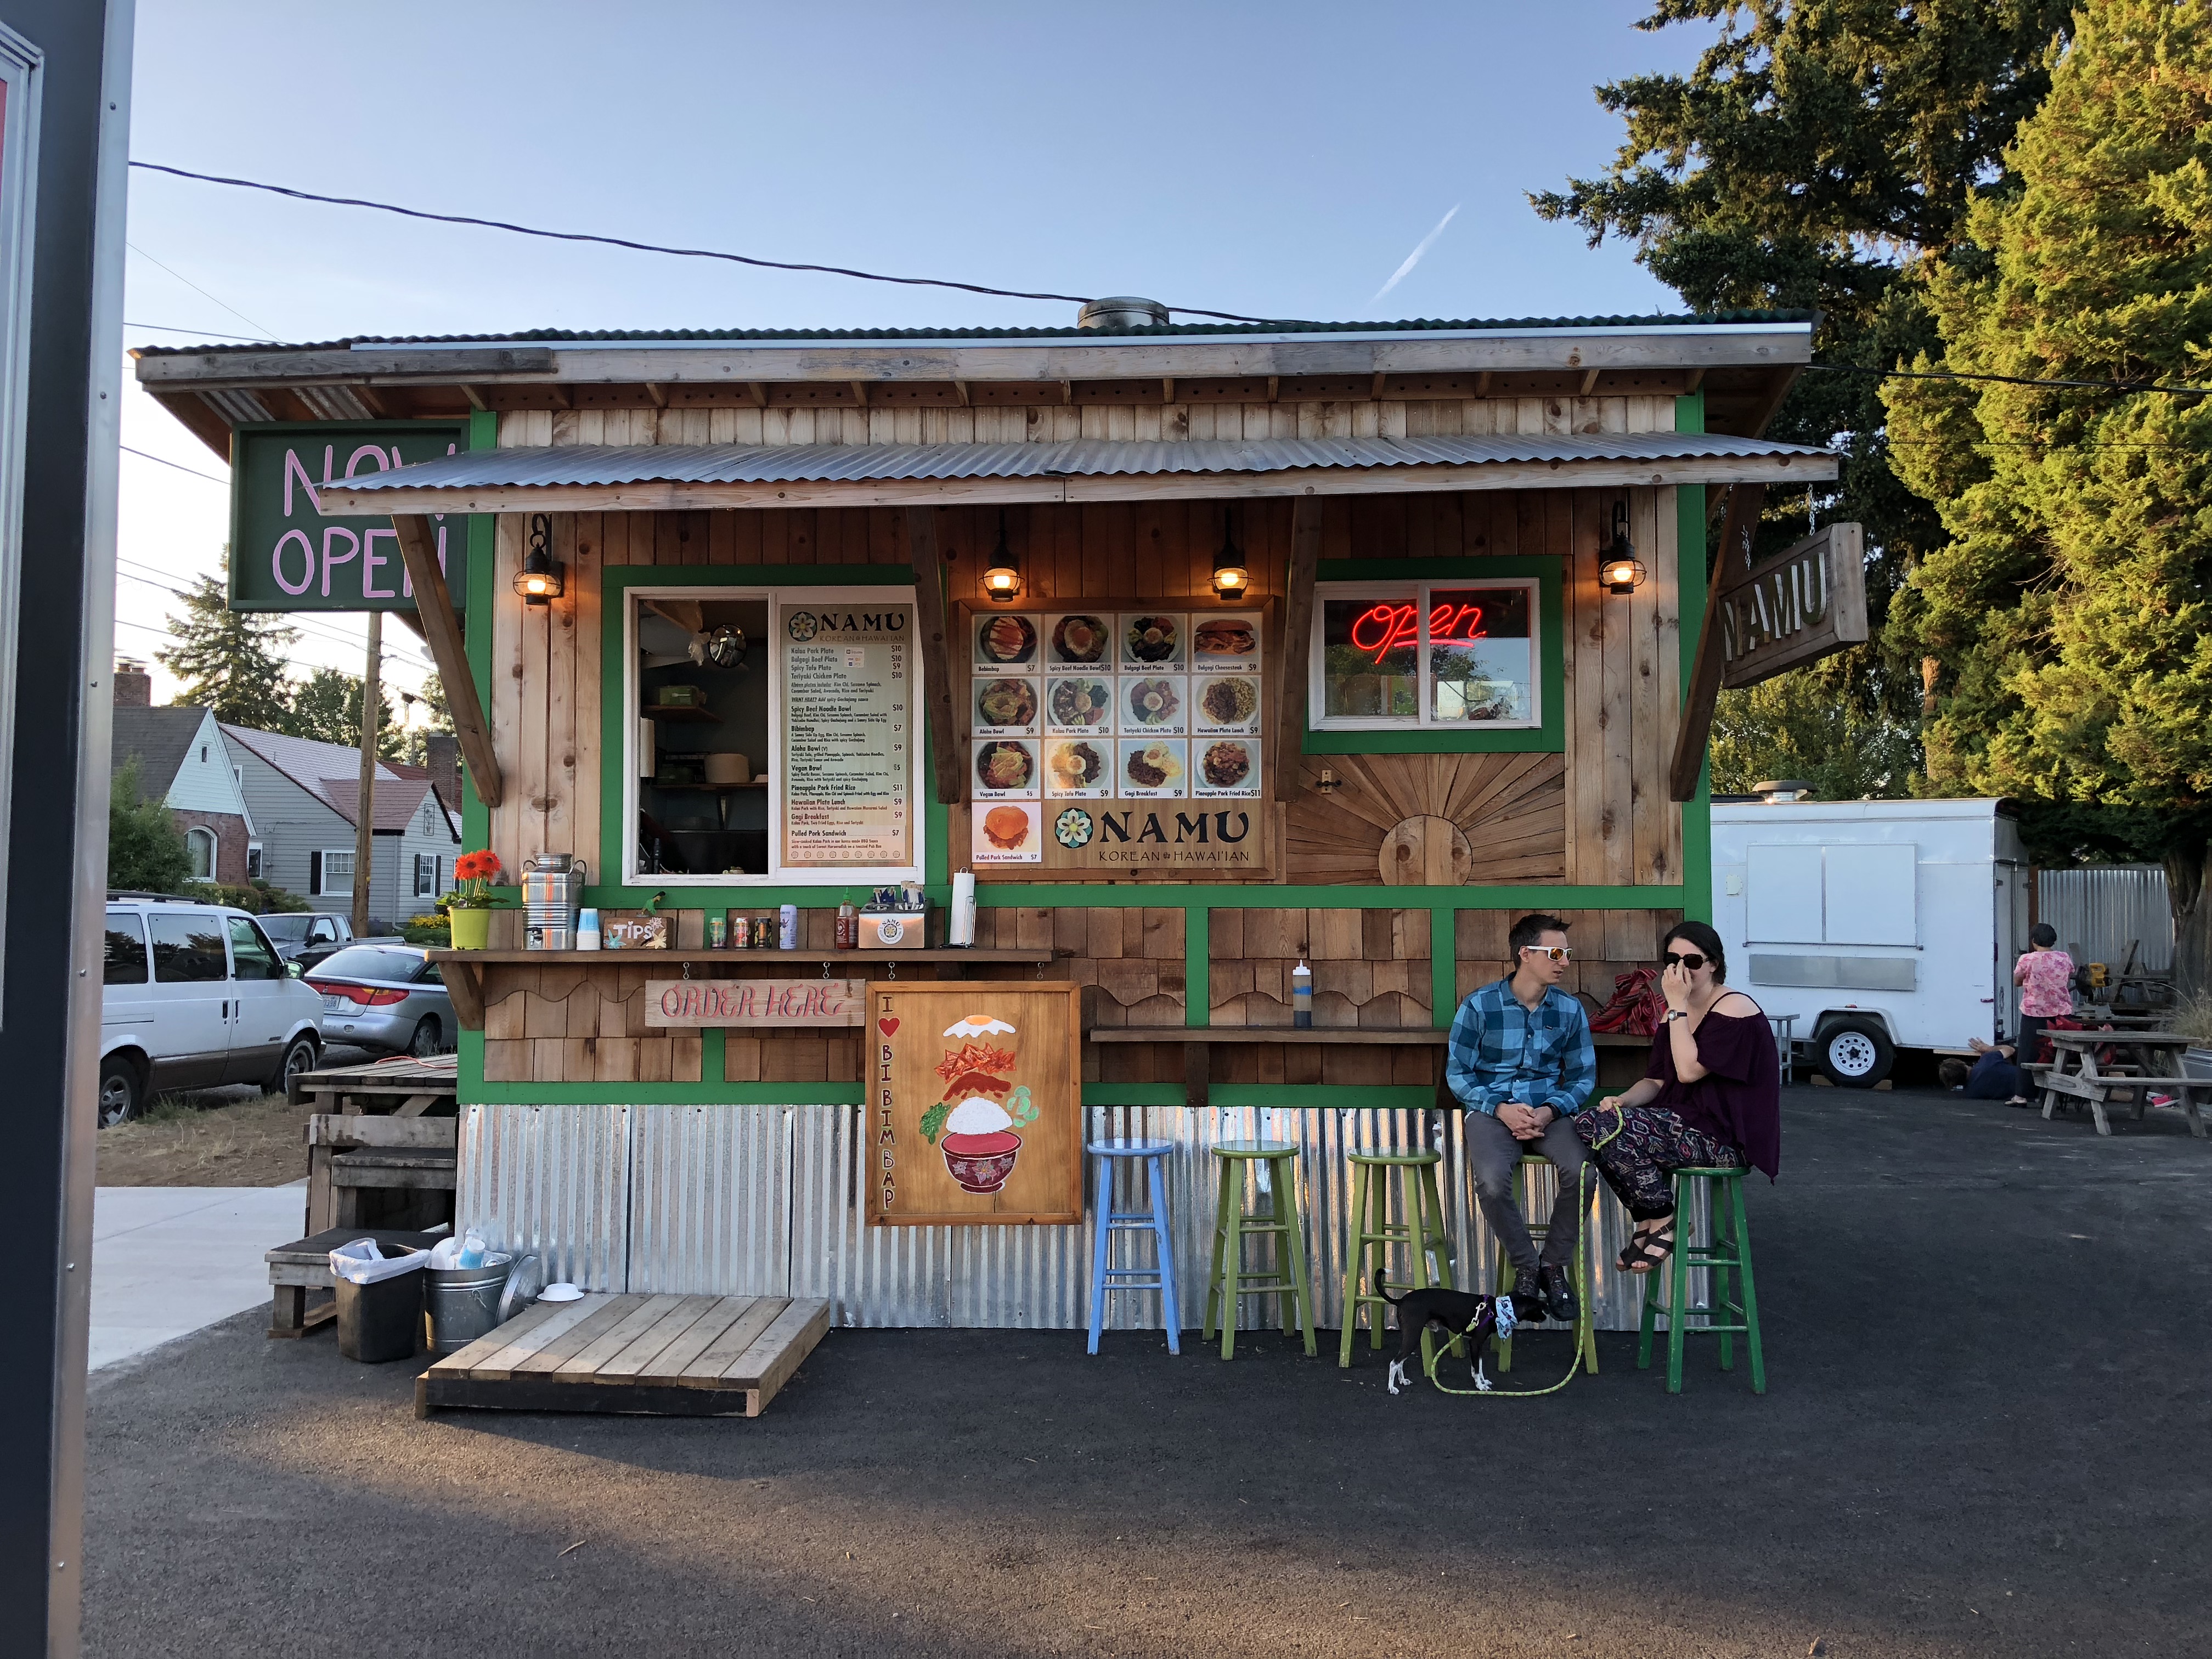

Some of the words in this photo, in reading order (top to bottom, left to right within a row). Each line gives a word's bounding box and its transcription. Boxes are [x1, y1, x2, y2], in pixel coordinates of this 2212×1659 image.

[1720, 552, 1827, 662] NAMU
[820, 613, 905, 631] NAMU
[1352, 605, 1487, 665] Open
[791, 673, 811, 681] Teriyaki
[1100, 811, 1249, 844] NAMU
[1099, 851, 1160, 861] KOREAN
[662, 984, 759, 1018] ORDER
[765, 983, 844, 1017] HERE
[883, 996, 893, 1012] I
